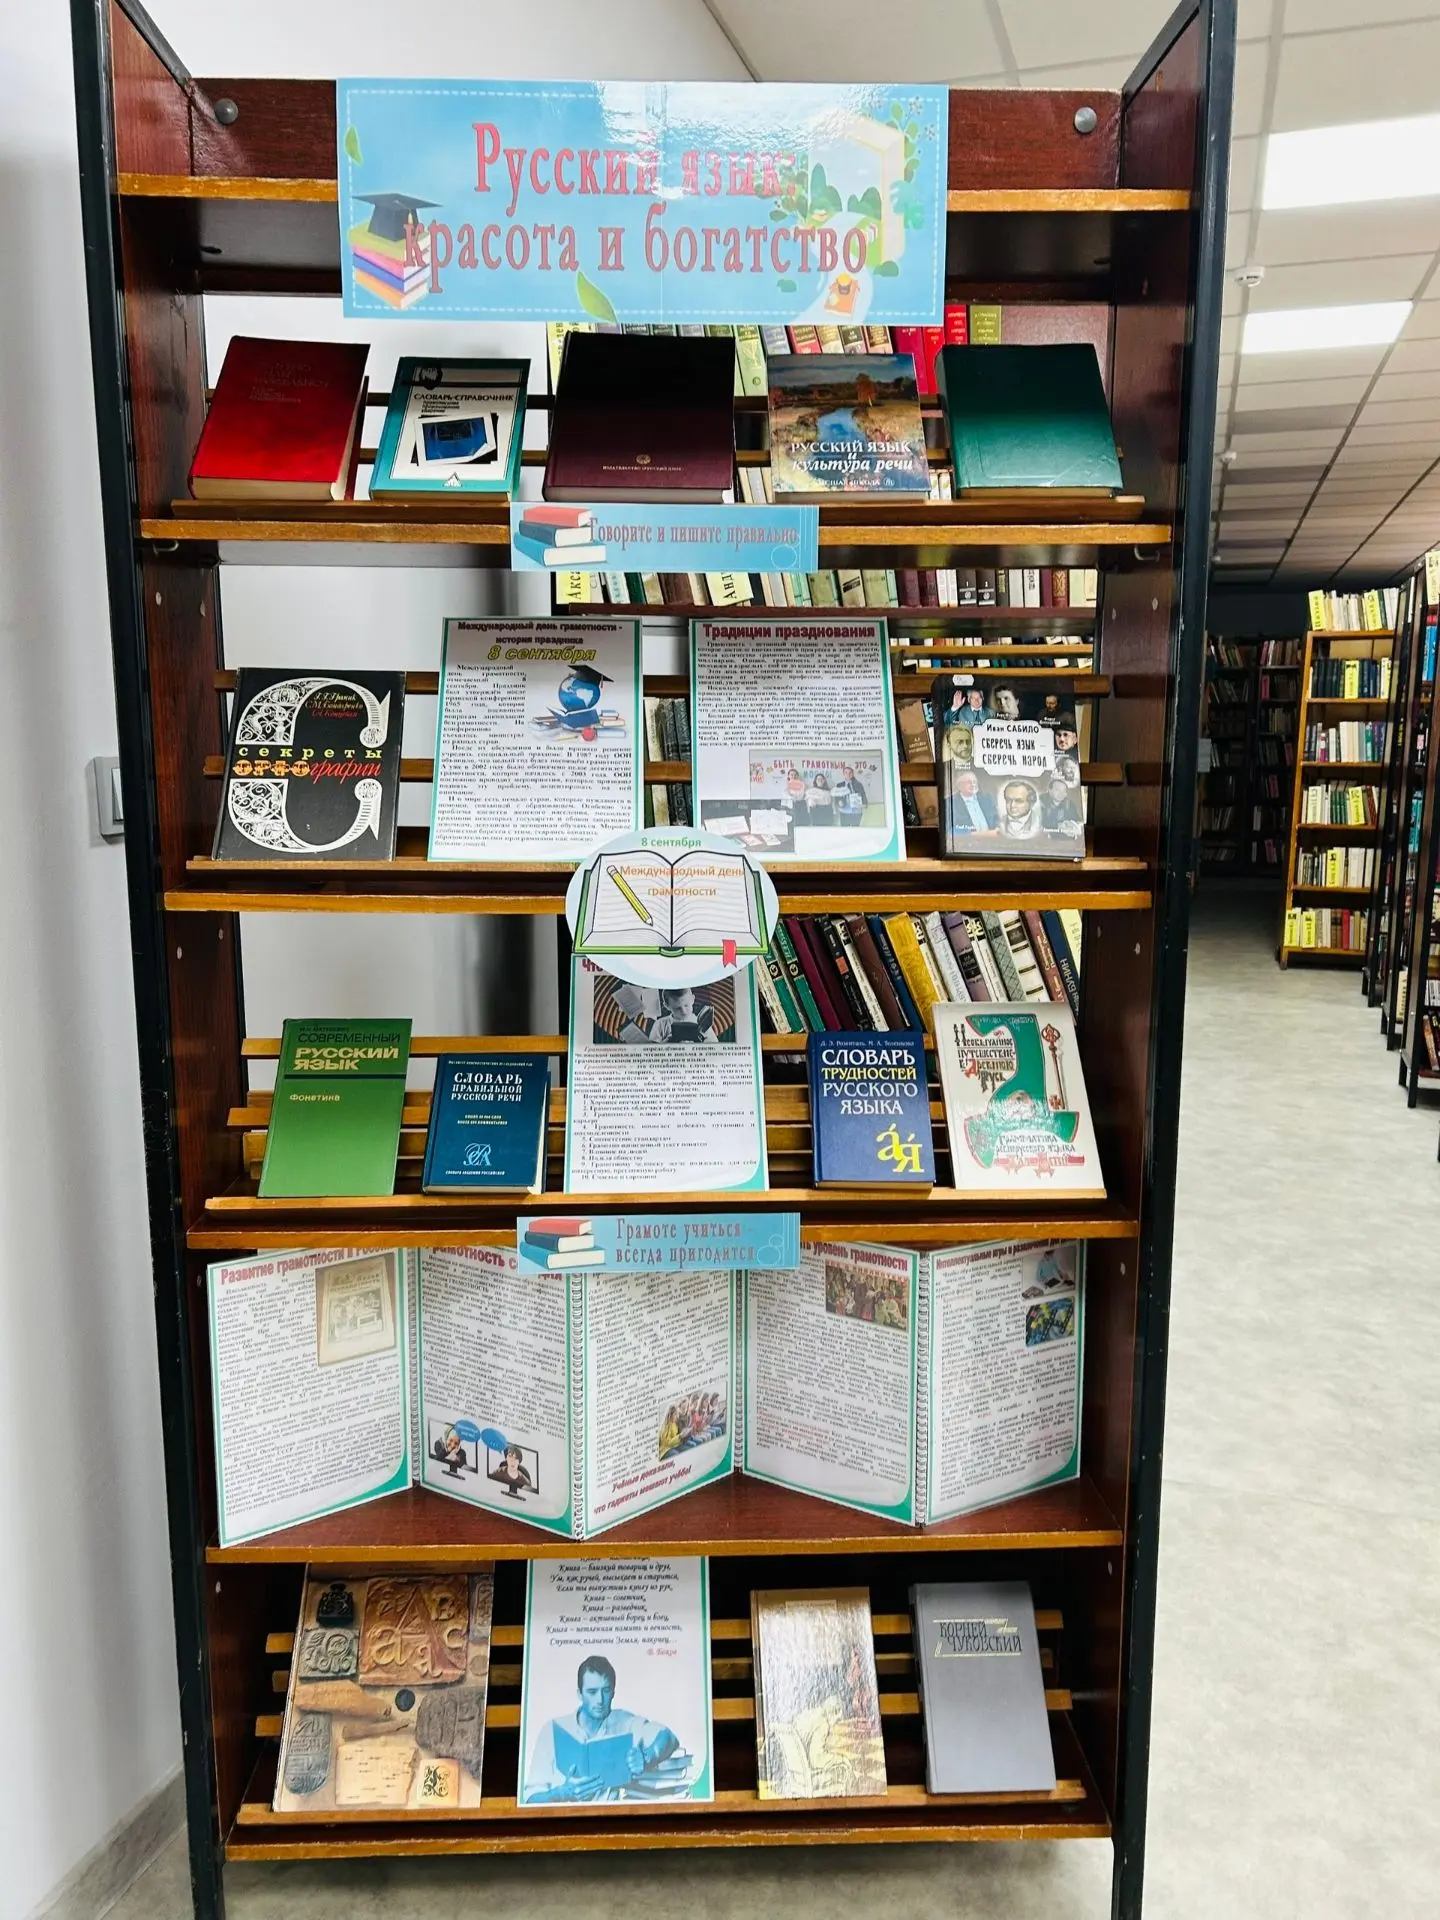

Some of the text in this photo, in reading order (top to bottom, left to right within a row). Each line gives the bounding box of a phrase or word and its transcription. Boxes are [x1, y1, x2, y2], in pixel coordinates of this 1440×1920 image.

[472, 122, 661, 216] Русский
[402, 202, 868, 293] красота и богатство
[791, 440, 912, 453] РУССКИЙ ЯЗЫК
[792, 460, 914, 473] культура речи
[589, 517, 797, 551] Говорите и пишите правильно
[458, 621, 534, 632] Международный
[535, 623, 557, 632] день
[560, 624, 617, 632] грамотности
[703, 623, 876, 640] Традиции празднования
[496, 637, 583, 645] история праздника
[487, 644, 597, 664] 8 сентября
[986, 724, 1040, 734] Иван САБИЛО
[981, 738, 1036, 750] СБЕРЕЧЬ ЯЗЫК
[239, 747, 382, 761] секреты
[982, 754, 1048, 768] СБЕРЕЧЬ НАРОД
[641, 836, 702, 848] 8 сентября
[619, 865, 745, 879] Международный день
[647, 887, 718, 898] грамотности
[298, 1032, 401, 1043] СОВРЕМЕННЫЙ
[295, 1045, 399, 1059] РУССКИЙ
[821, 1049, 915, 1066] СЛОВАРЬ
[293, 1059, 360, 1071] ЯЗЫК
[454, 1072, 523, 1085] СЛОВАРЬ
[821, 1066, 917, 1081] ТРУДНОСТЕЙ
[452, 1084, 523, 1094] ПРАВИЛЬНОЙ
[822, 1082, 919, 1098] РУССКОГО
[451, 1093, 521, 1102] РУССКОЙ РЕЧИ
[840, 1099, 904, 1115] ЯЗЫКА
[616, 1218, 741, 1246] Грамоте учиться
[616, 1245, 756, 1269] всегда пригодится
[850, 1248, 908, 1271] грамотности
[221, 1264, 274, 1285] Развитие
[277, 1250, 345, 1276] грамотности
[559, 1564, 580, 1572] Книга
[940, 1620, 988, 1637] КОРНЕЙ
[947, 1635, 1022, 1652] ЧУКОВСКИЙ
